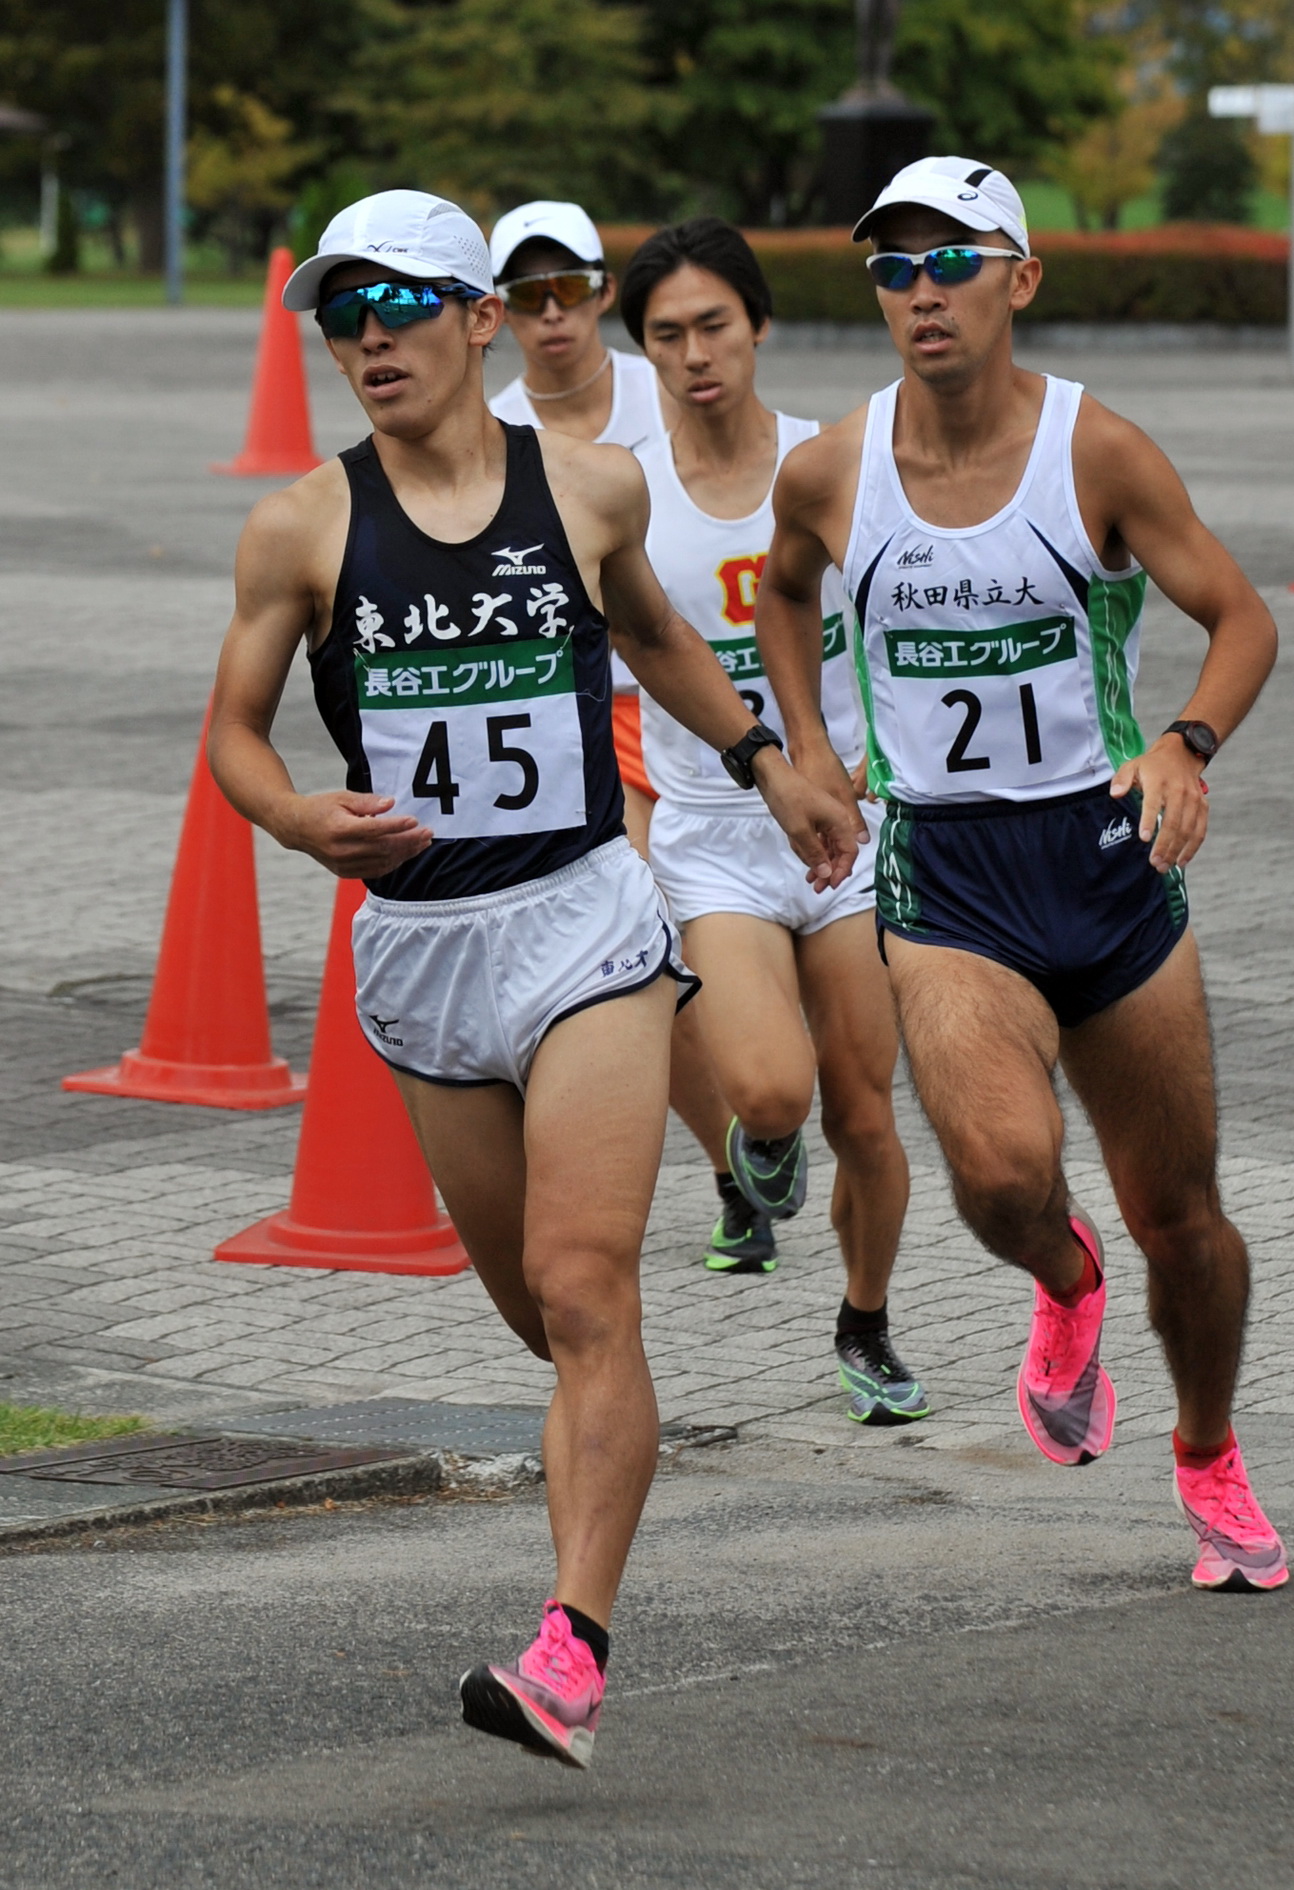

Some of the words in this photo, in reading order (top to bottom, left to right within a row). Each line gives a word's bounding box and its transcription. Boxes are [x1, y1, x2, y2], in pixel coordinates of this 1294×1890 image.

[492, 564, 546, 577] MIZUNO
[891, 576, 1044, 612] 秋田県立大
[353, 583, 570, 654] 東北大学
[895, 622, 1067, 667] 長谷工グループ
[365, 649, 564, 697] 長谷工グループ
[941, 683, 1042, 773] 21
[412, 713, 539, 815] 45
